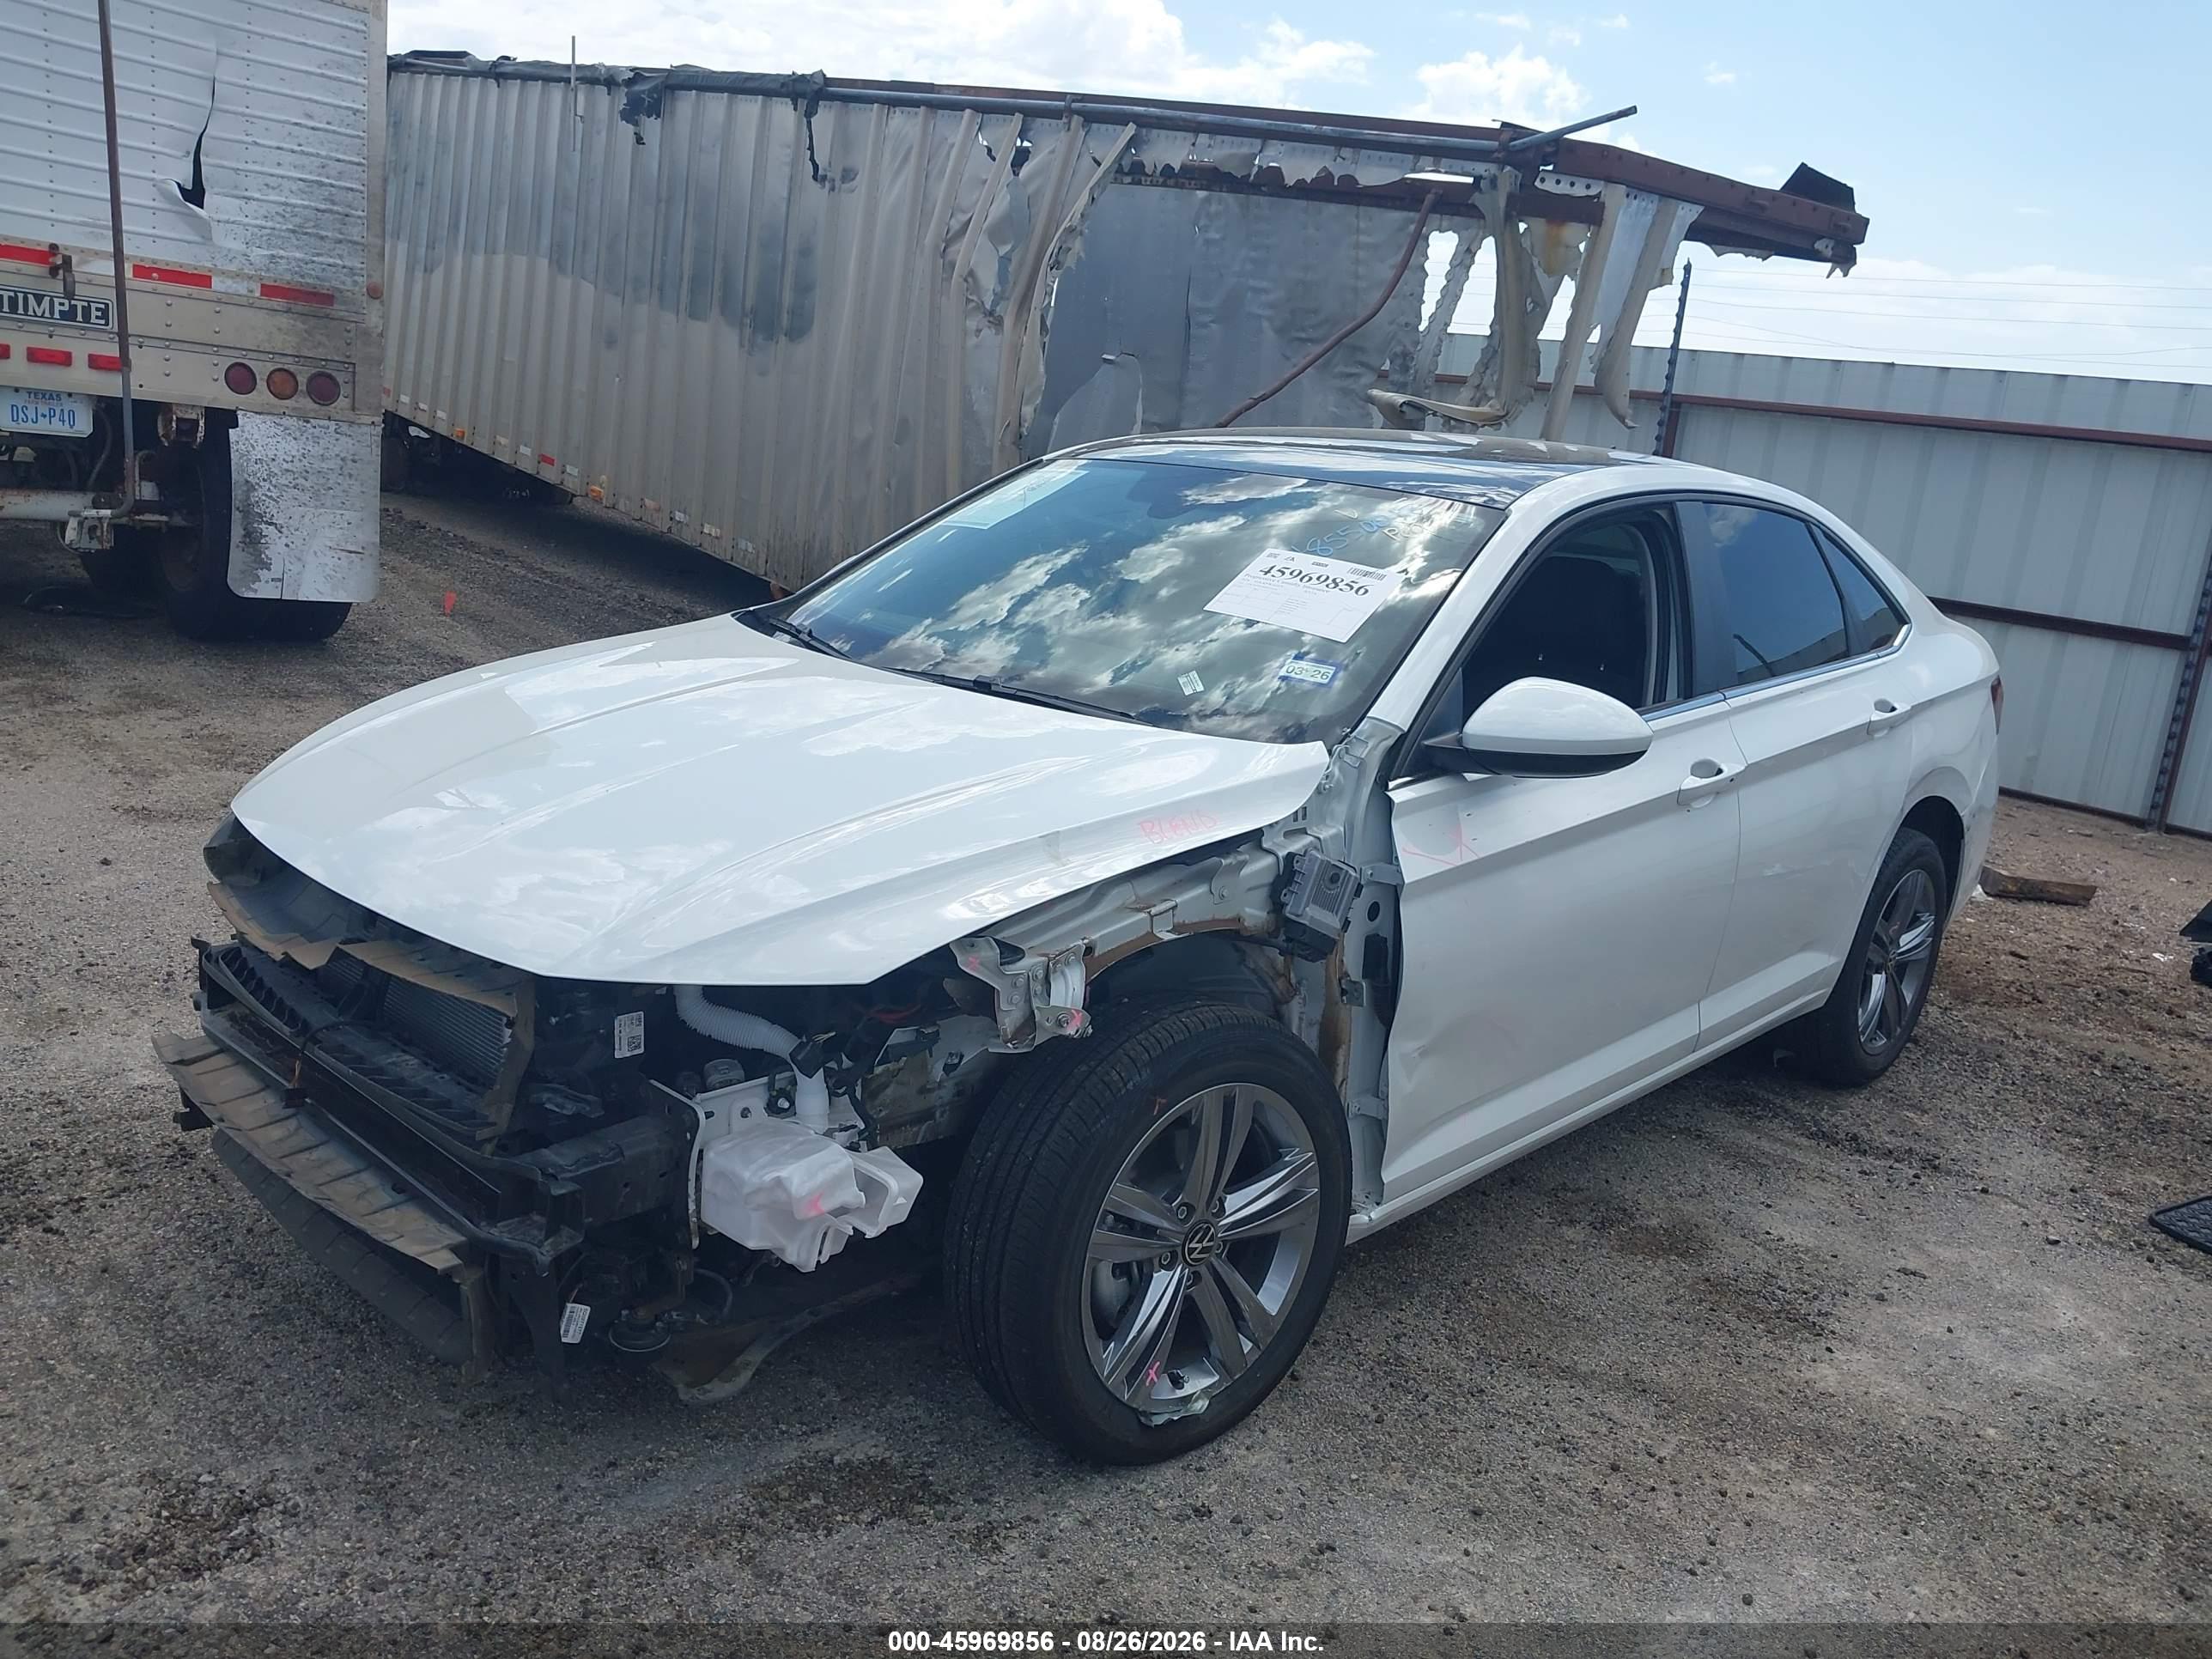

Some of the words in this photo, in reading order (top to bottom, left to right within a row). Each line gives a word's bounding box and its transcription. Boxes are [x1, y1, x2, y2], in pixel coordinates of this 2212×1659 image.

[0, 291, 106, 325] TIMPTE
[27, 392, 62, 401] TEXAS
[1259, 564, 1374, 597] 45969856
[1285, 665, 1304, 676] 03
[1310, 669, 1330, 680] 26
